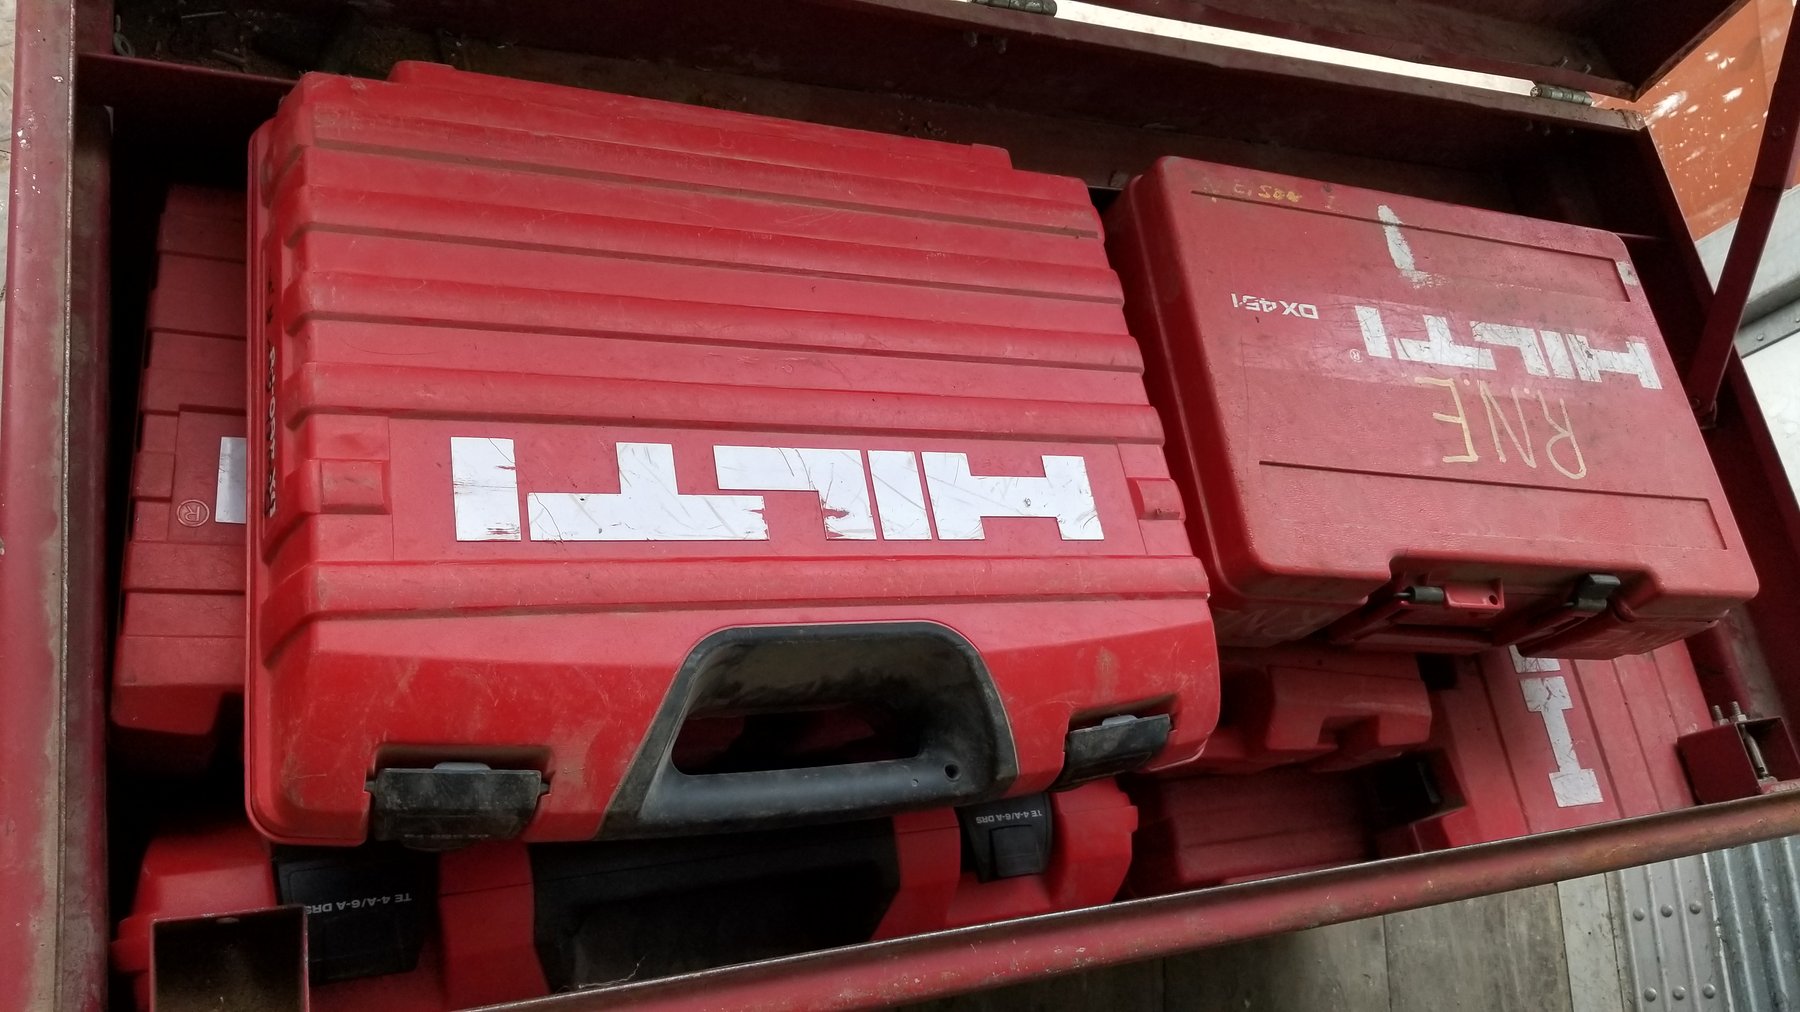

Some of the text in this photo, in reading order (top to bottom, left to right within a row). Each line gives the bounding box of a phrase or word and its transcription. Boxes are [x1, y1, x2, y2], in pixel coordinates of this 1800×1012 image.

[1355, 305, 1663, 389] HILTI
[451, 436, 1104, 541] HILTI
[975, 809, 1043, 824] TE 4-A/6-A DRS
[304, 892, 413, 914] TE 4-A/6-A DRS
